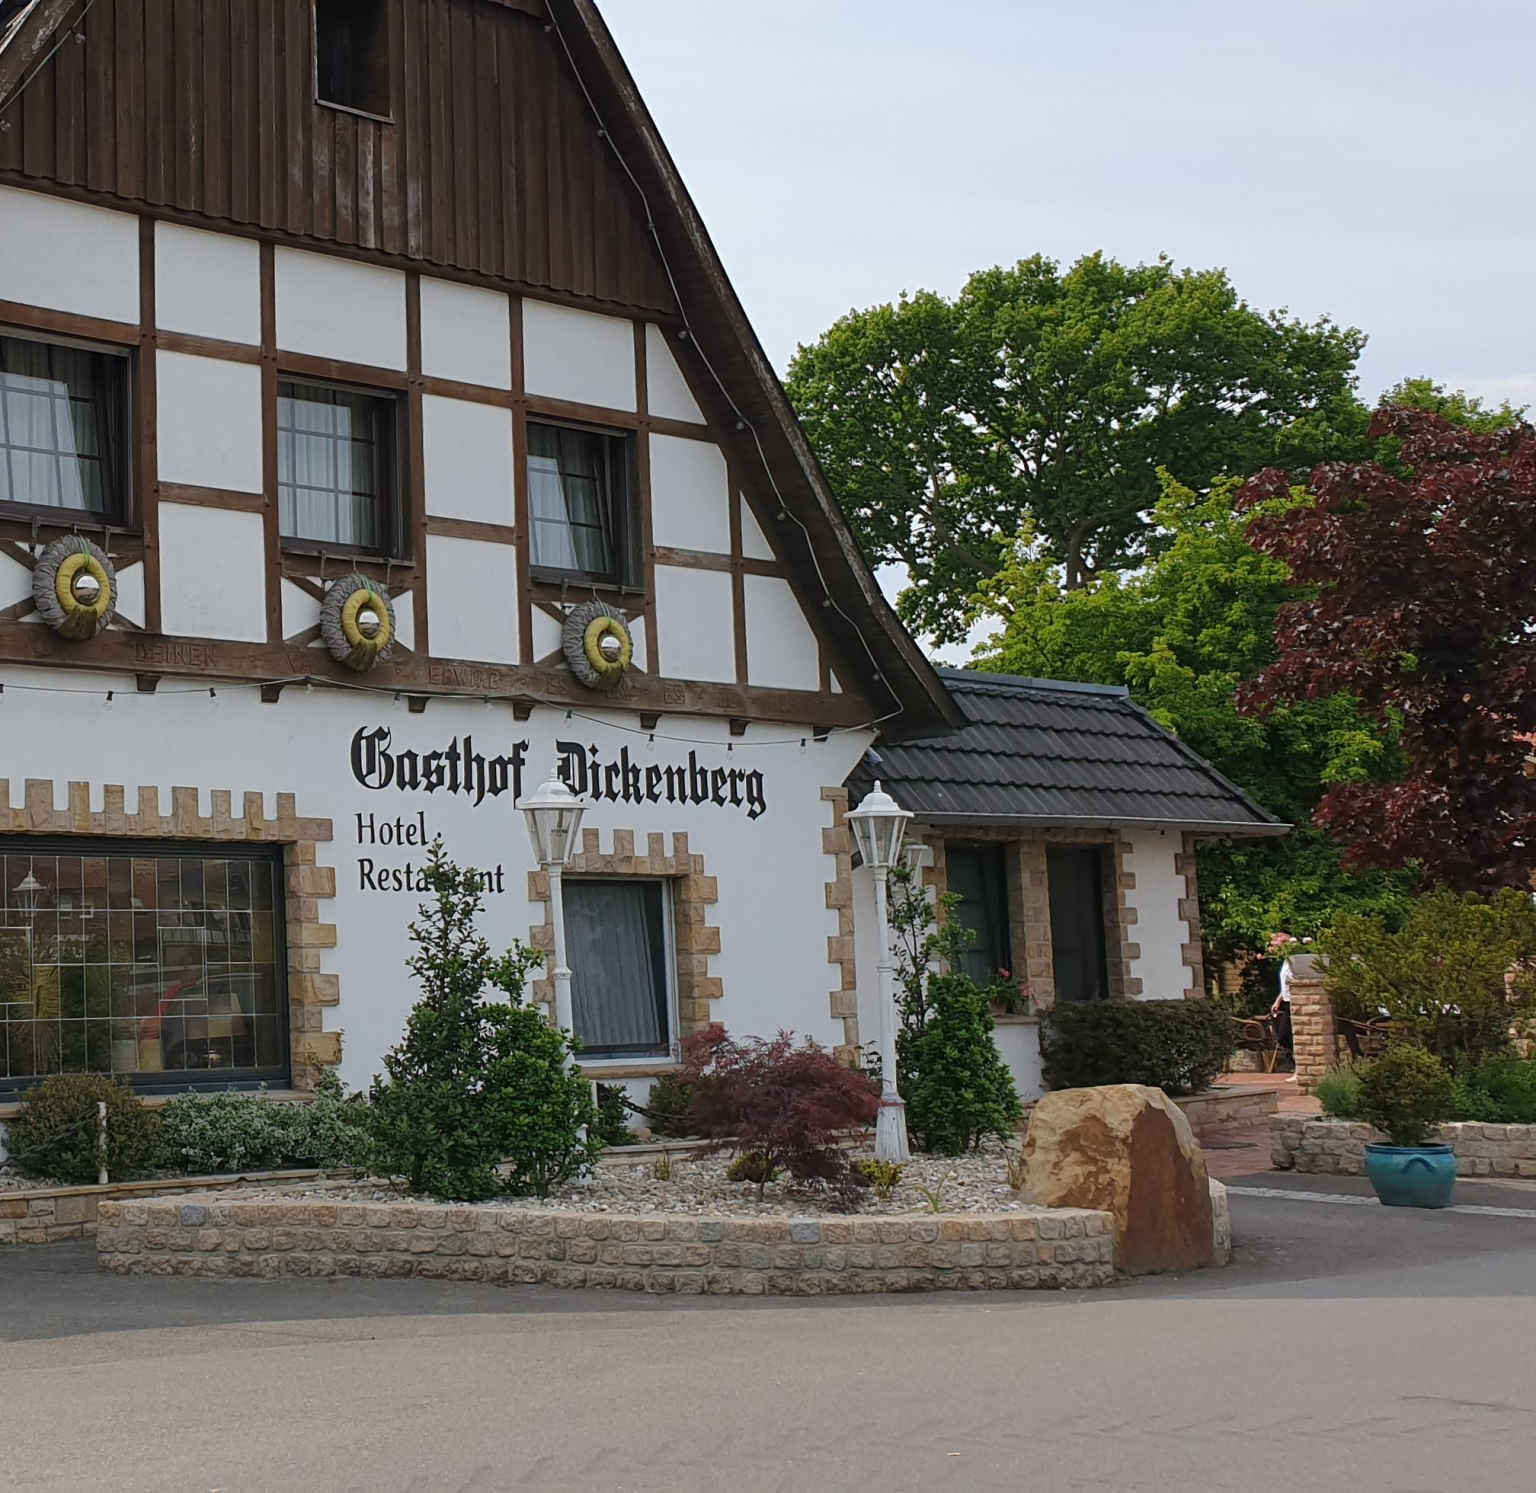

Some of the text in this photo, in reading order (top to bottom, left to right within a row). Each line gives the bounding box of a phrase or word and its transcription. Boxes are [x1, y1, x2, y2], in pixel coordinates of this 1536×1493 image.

[350, 725, 767, 820] Gasthof Dickenberg
[354, 811, 429, 847] Hotel
[357, 858, 506, 894] Restant
